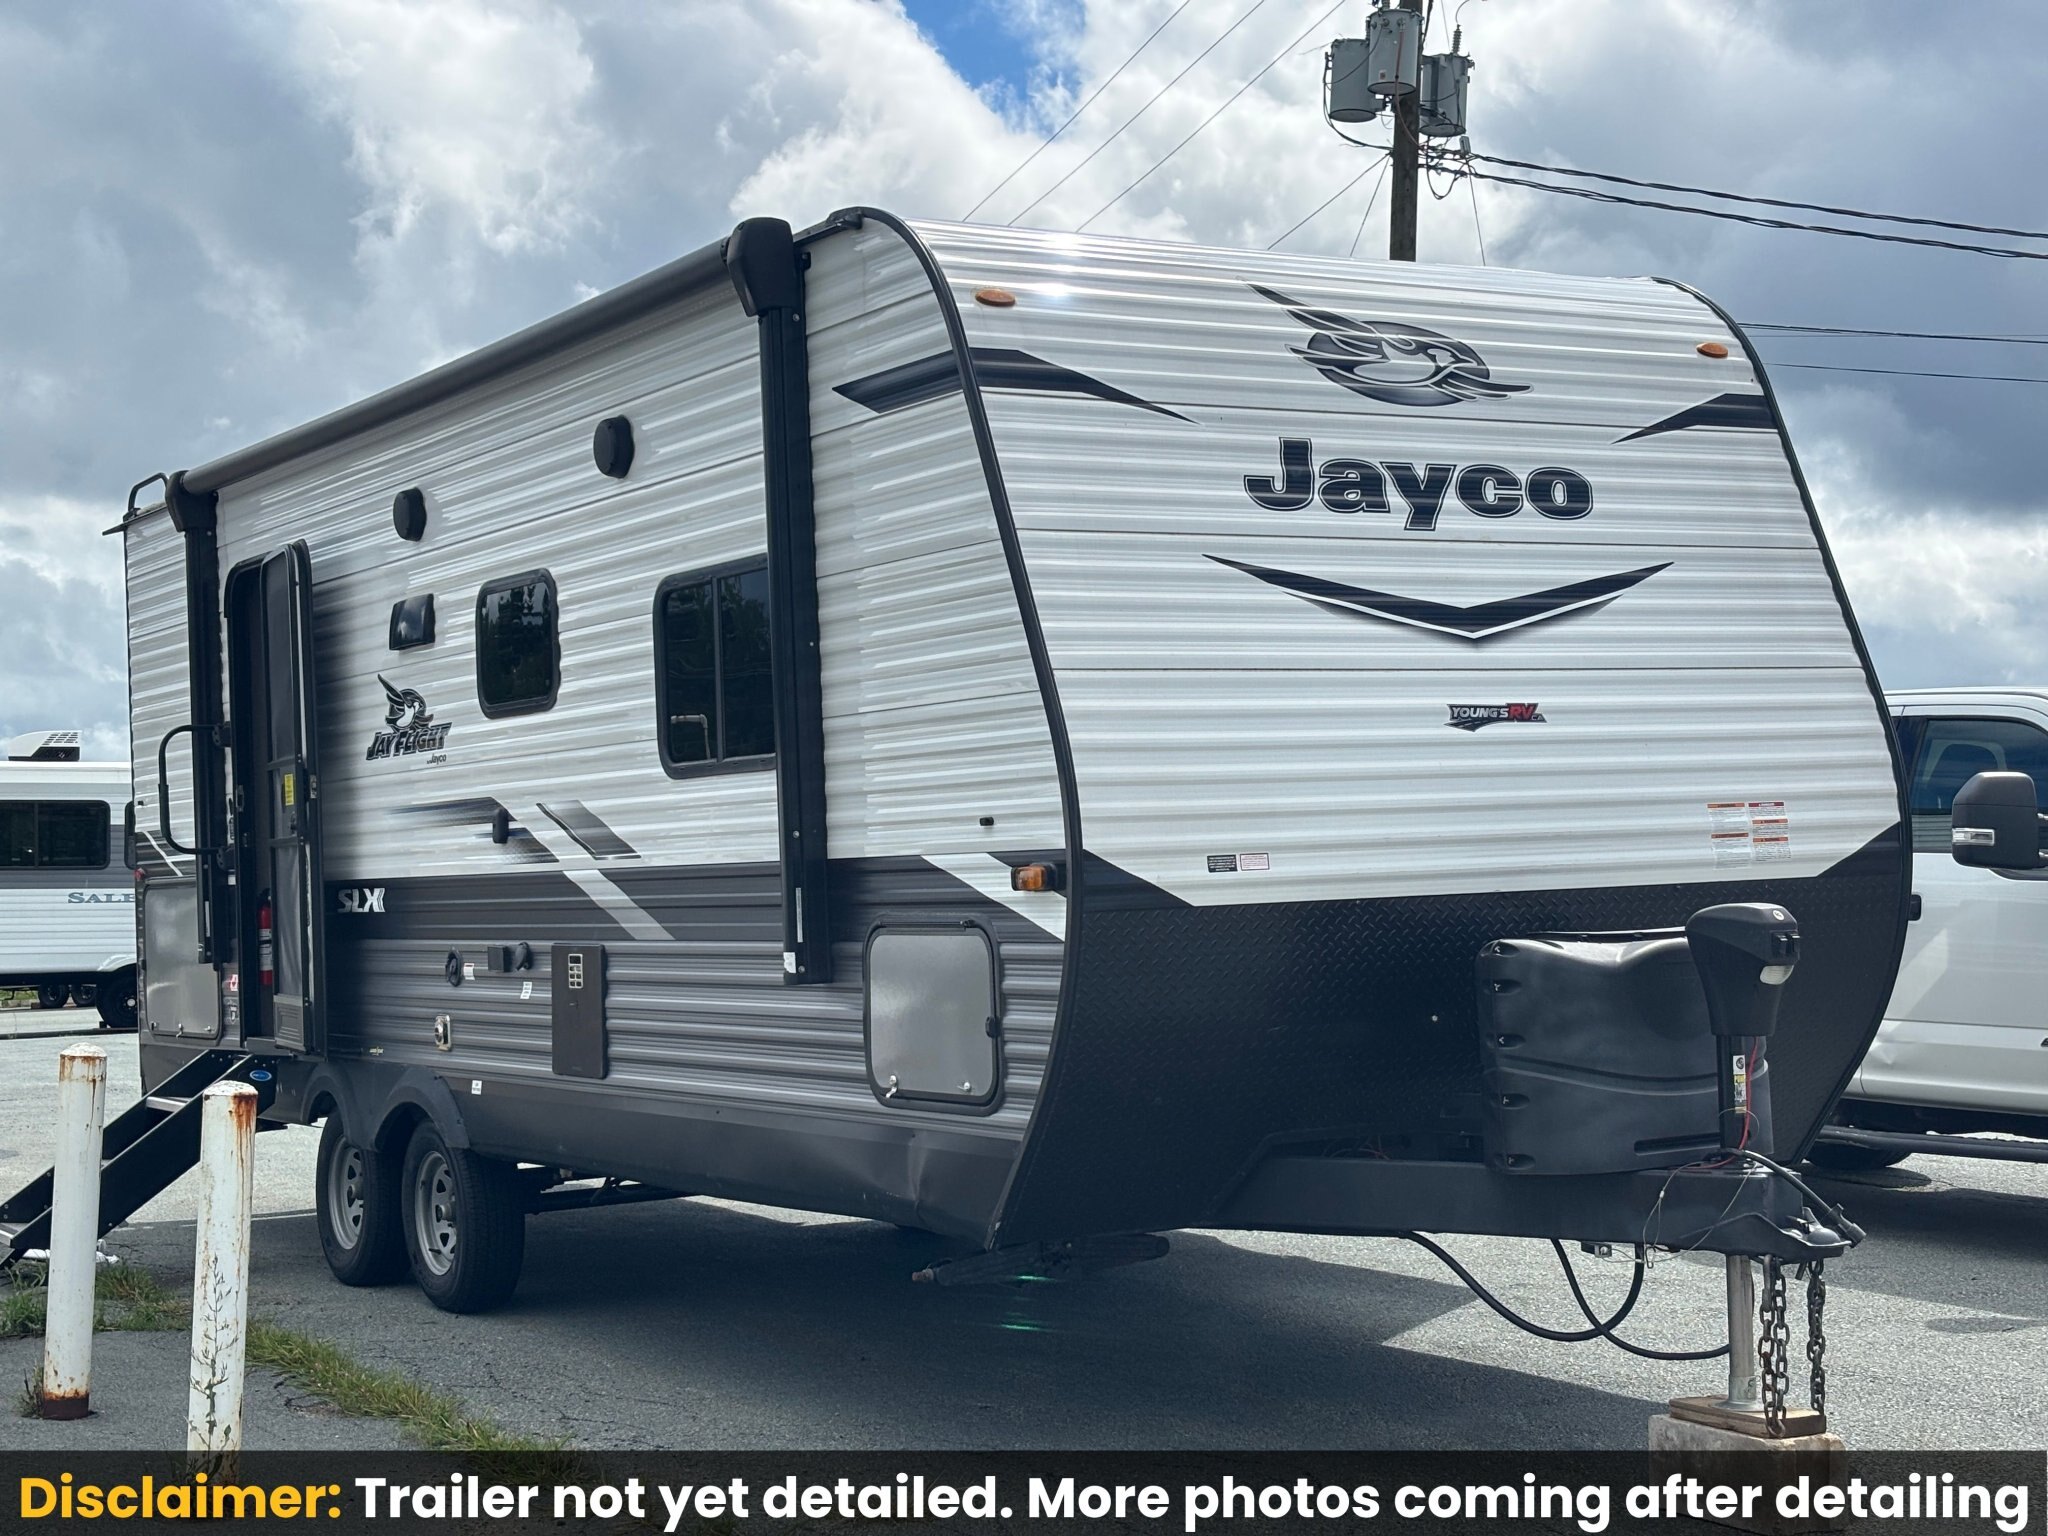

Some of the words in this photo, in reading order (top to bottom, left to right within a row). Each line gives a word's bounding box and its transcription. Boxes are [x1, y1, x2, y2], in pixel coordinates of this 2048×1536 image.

[1243, 436, 1594, 531] Jayco
[366, 731, 398, 760] JAY
[393, 722, 452, 757] FLIGHT
[338, 887, 386, 913] SLX
